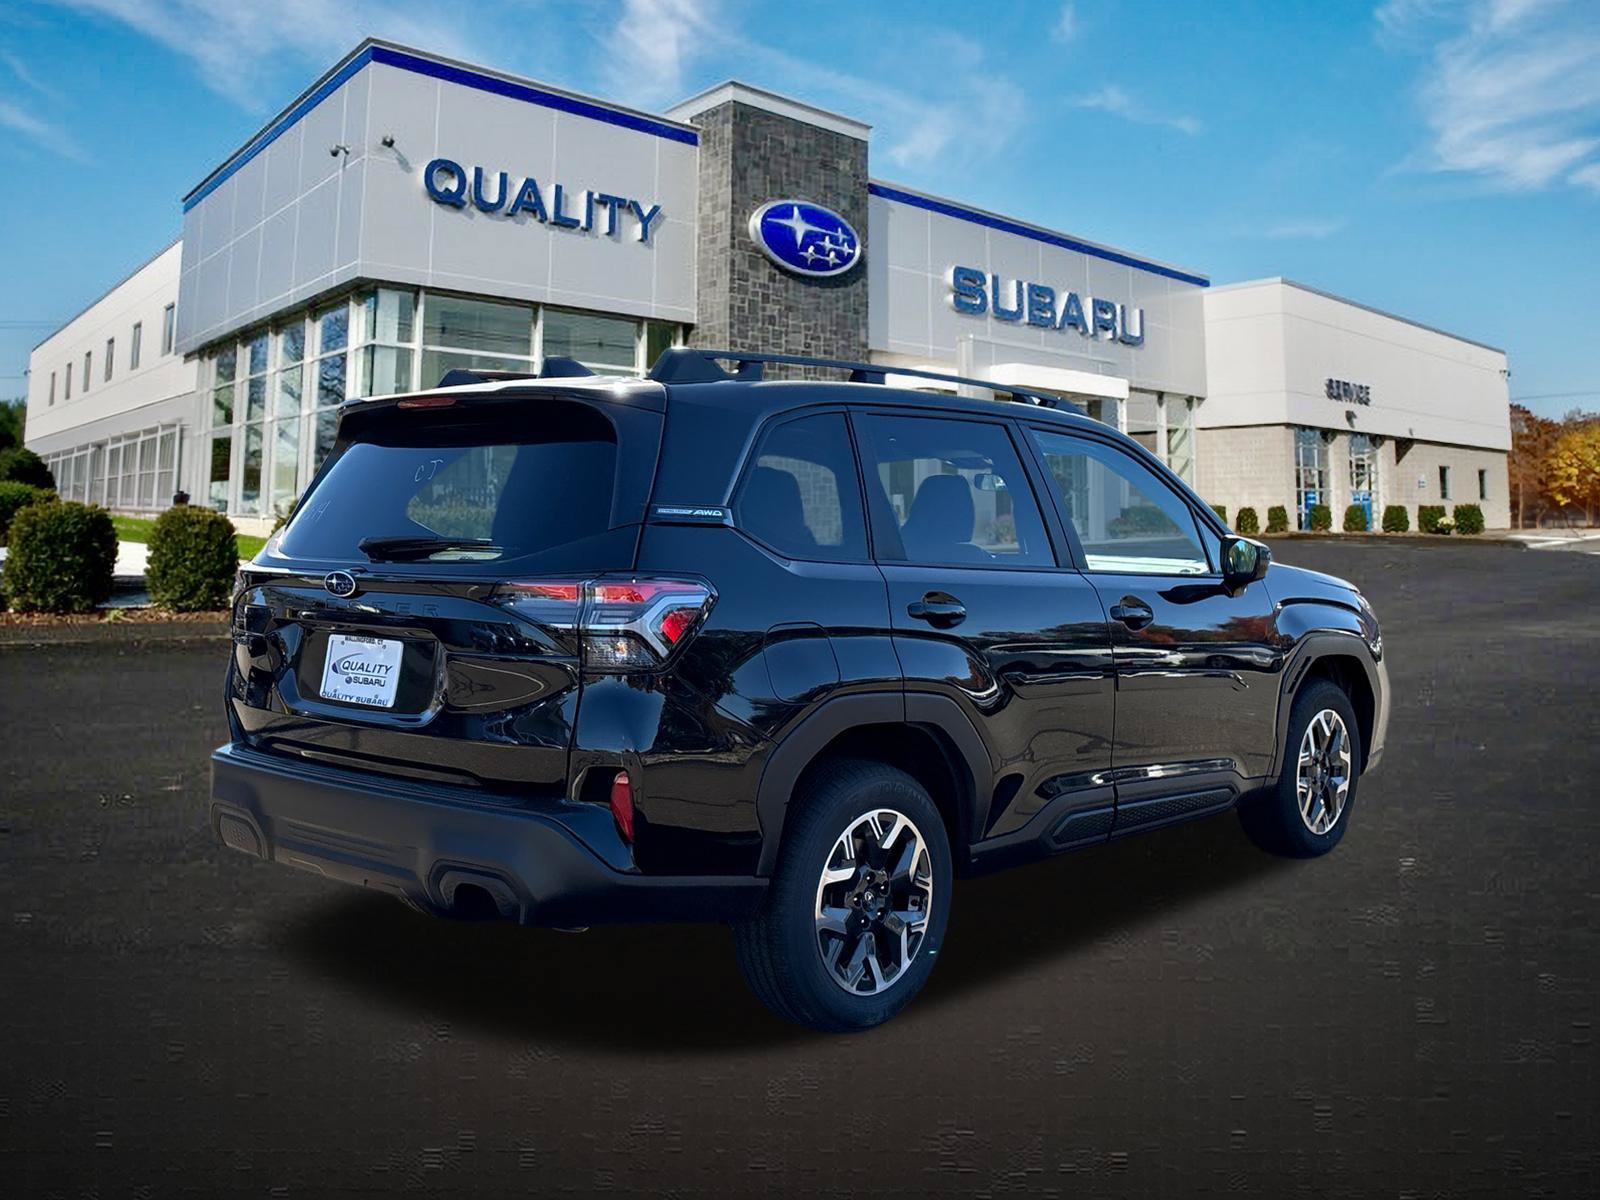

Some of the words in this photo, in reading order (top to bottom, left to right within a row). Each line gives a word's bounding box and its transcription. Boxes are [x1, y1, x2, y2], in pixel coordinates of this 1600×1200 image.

[424, 158, 662, 243] QUALITY
[952, 265, 1145, 347] SUBARU
[693, 508, 723, 517] AWD
[341, 660, 393, 675] QUALITY
[352, 676, 386, 688] SUBARU
[321, 691, 354, 702] QUALITY
[355, 696, 388, 707] SUBARU
